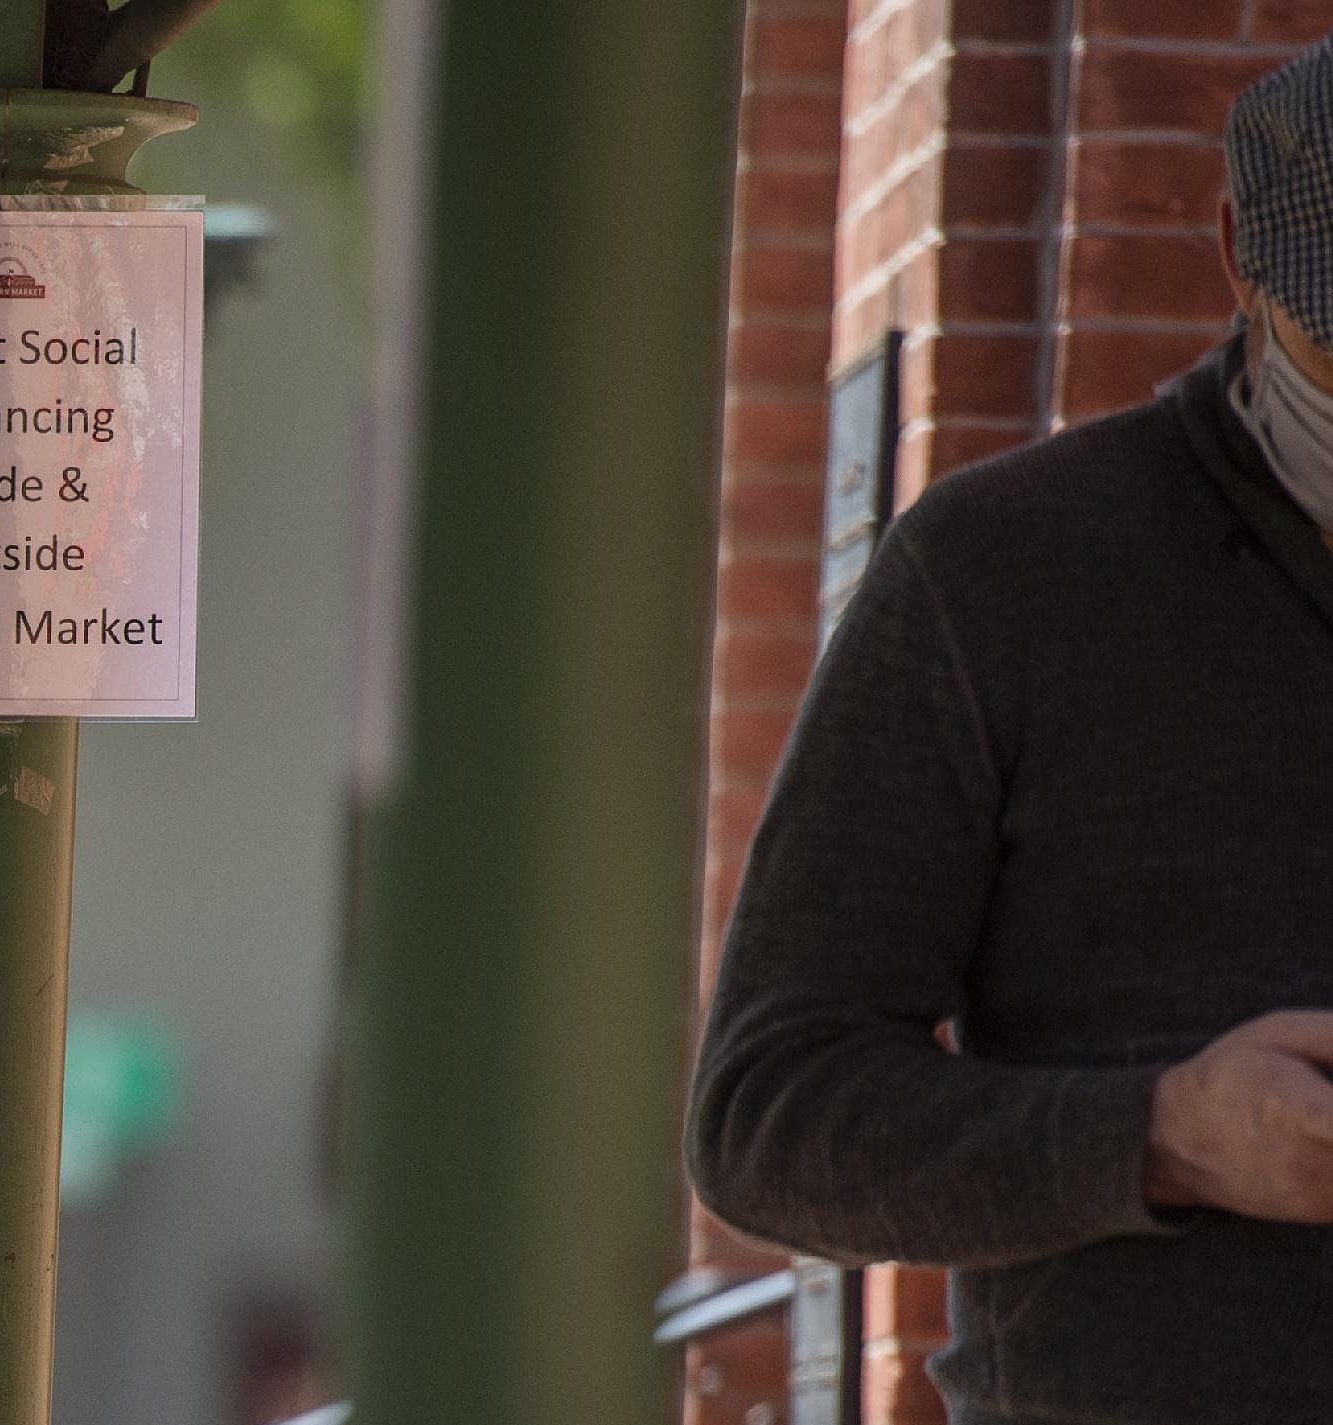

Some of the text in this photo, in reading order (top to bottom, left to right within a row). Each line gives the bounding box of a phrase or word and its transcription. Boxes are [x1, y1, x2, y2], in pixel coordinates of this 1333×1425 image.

[20, 328, 137, 365] Social
[58, 466, 90, 503] &
[15, 608, 163, 645] Market
